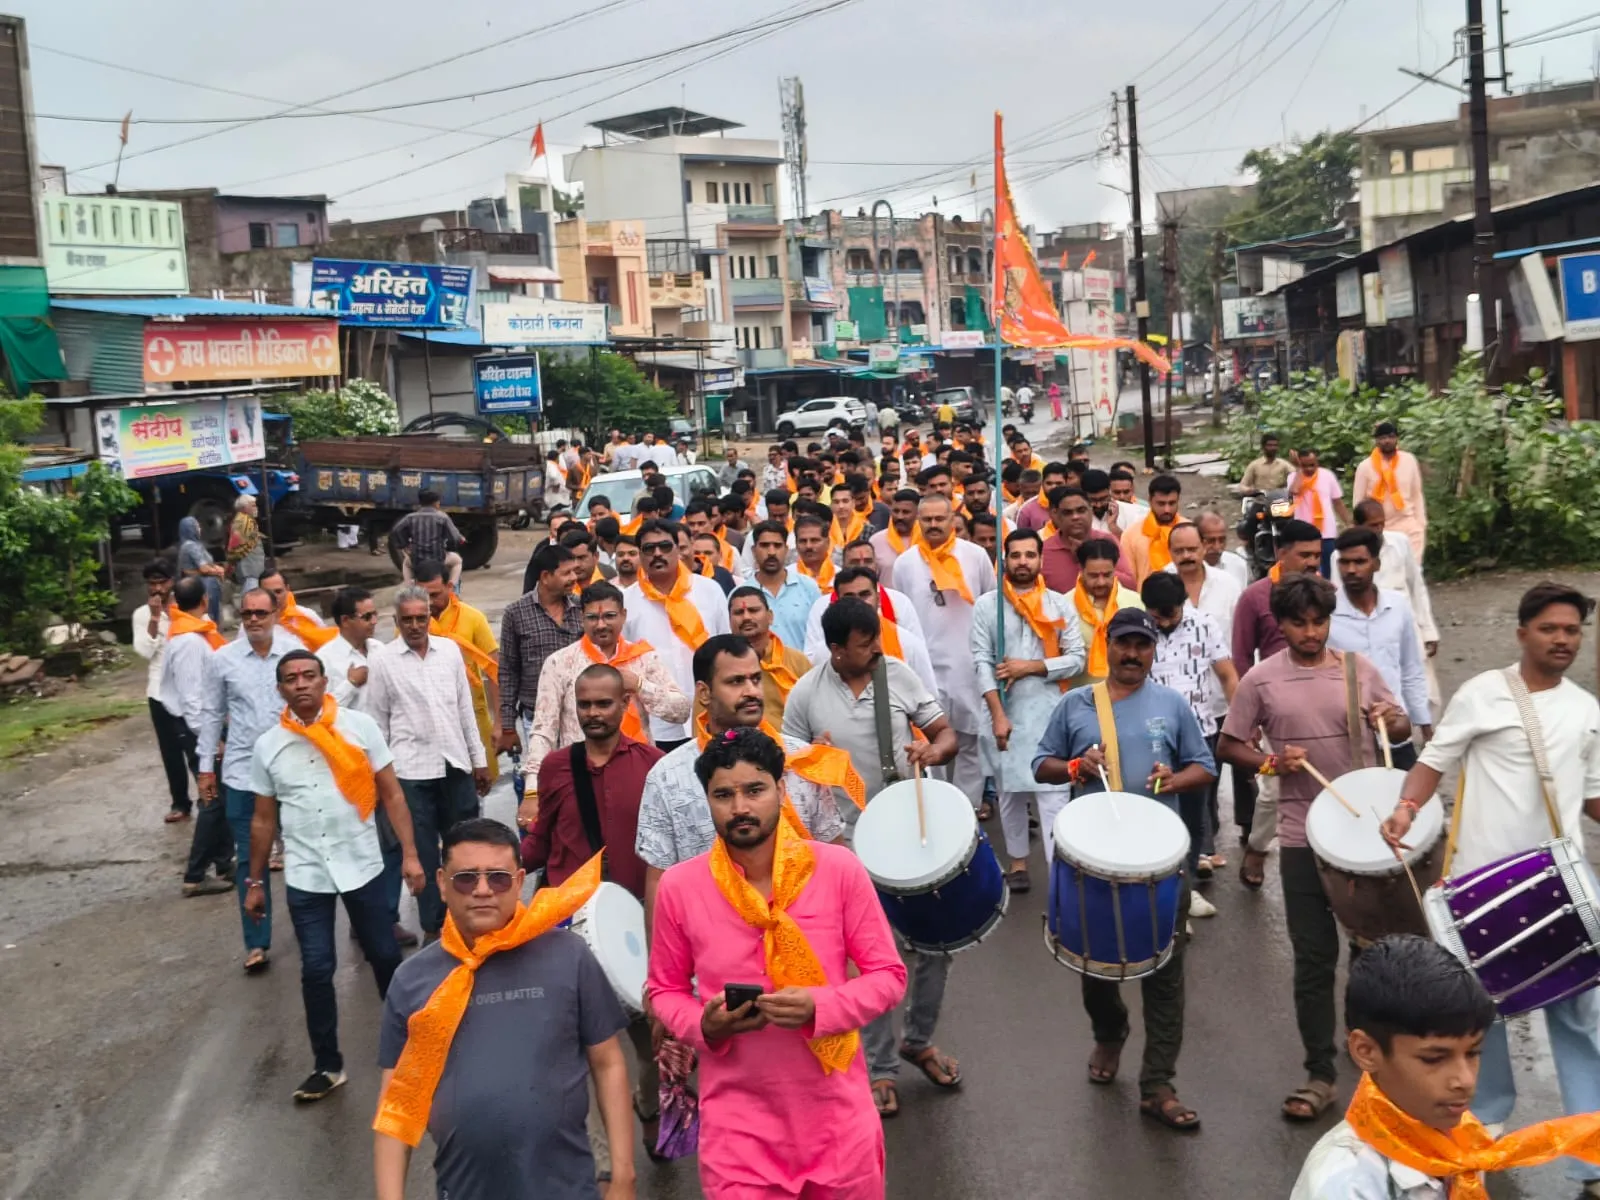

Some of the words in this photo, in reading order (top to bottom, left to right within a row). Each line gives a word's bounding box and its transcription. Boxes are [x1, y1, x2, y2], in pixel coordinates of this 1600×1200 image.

[351, 268, 428, 298] अरिहंत
[547, 313, 583, 330] किराना
[178, 339, 204, 367] जय
[208, 329, 254, 367] भवानी
[256, 328, 308, 366] मेडिकल
[131, 414, 183, 440] संदीप
[475, 991, 503, 1006] OVER
[505, 987, 545, 1001] MATTER
